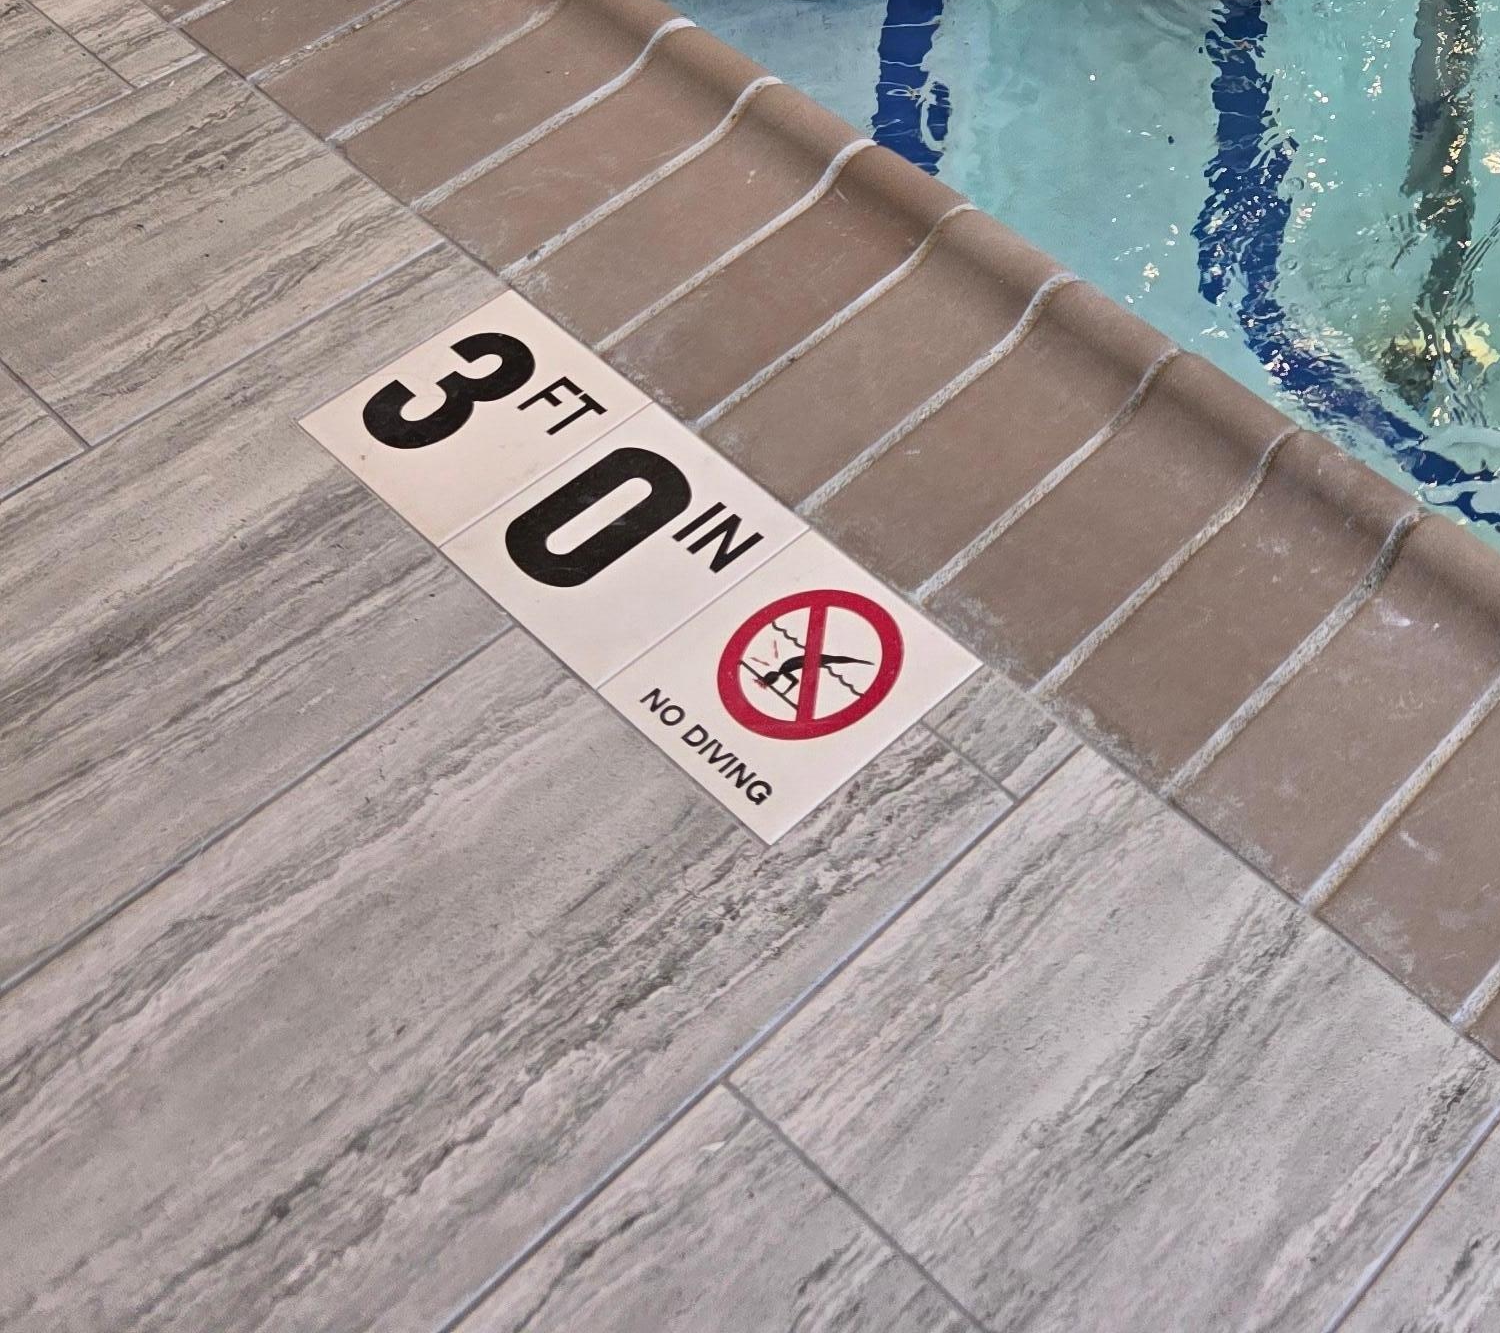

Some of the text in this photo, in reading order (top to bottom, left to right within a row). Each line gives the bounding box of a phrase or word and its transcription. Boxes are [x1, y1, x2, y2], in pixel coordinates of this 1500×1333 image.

[362, 331, 764, 588] 3 FT 0 IN
[640, 687, 774, 808] NO DIVING
